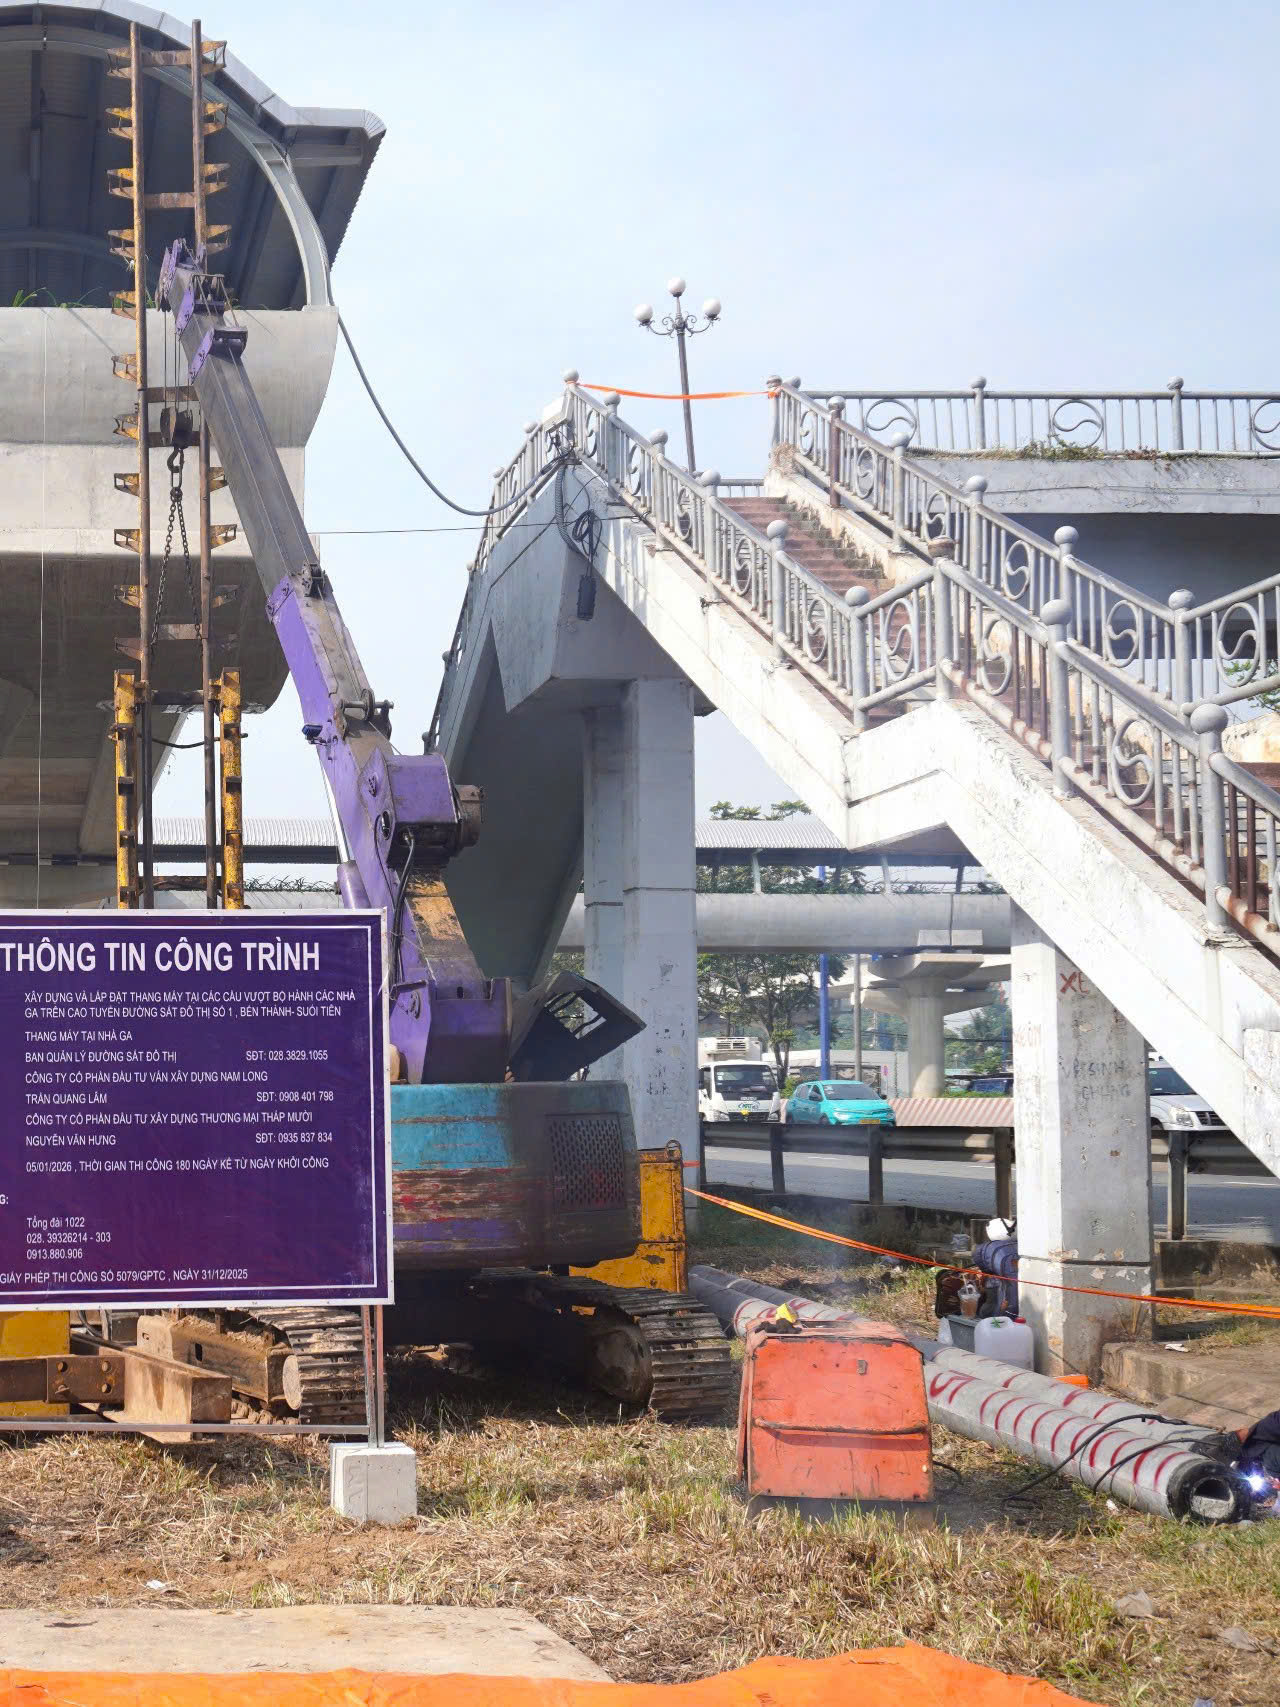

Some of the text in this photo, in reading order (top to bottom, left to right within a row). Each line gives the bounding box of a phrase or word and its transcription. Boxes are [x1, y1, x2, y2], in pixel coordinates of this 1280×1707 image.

[0, 937, 96, 972] THÔNG
[103, 943, 148, 971] TIN
[154, 937, 234, 971] CÔNG
[240, 936, 320, 971] TRÌNH
[25, 1029, 133, 1043] THANG MÁY TẠI NHÀ GA
[245, 1050, 328, 1060] SĐT: 028.3829.1055
[256, 1091, 334, 1102] SĐT: 0908 401 798
[255, 1132, 333, 1143] SĐT: 0935 837 834
[26, 1216, 85, 1230] Tổng đài 1022
[26, 1232, 111, 1243] 028. 39326214 303
[26, 1248, 83, 1259] 0913.880.906
[24, 1271, 50, 1284] PHÉP
[52, 1272, 68, 1282] THI
[70, 1270, 98, 1282] CÔNG
[100, 1269, 114, 1281] SỐ
[116, 1270, 166, 1281] 5079/GPTC
[173, 1268, 200, 1280] NGÀY
[201, 1269, 248, 1279] 31/12/2025
